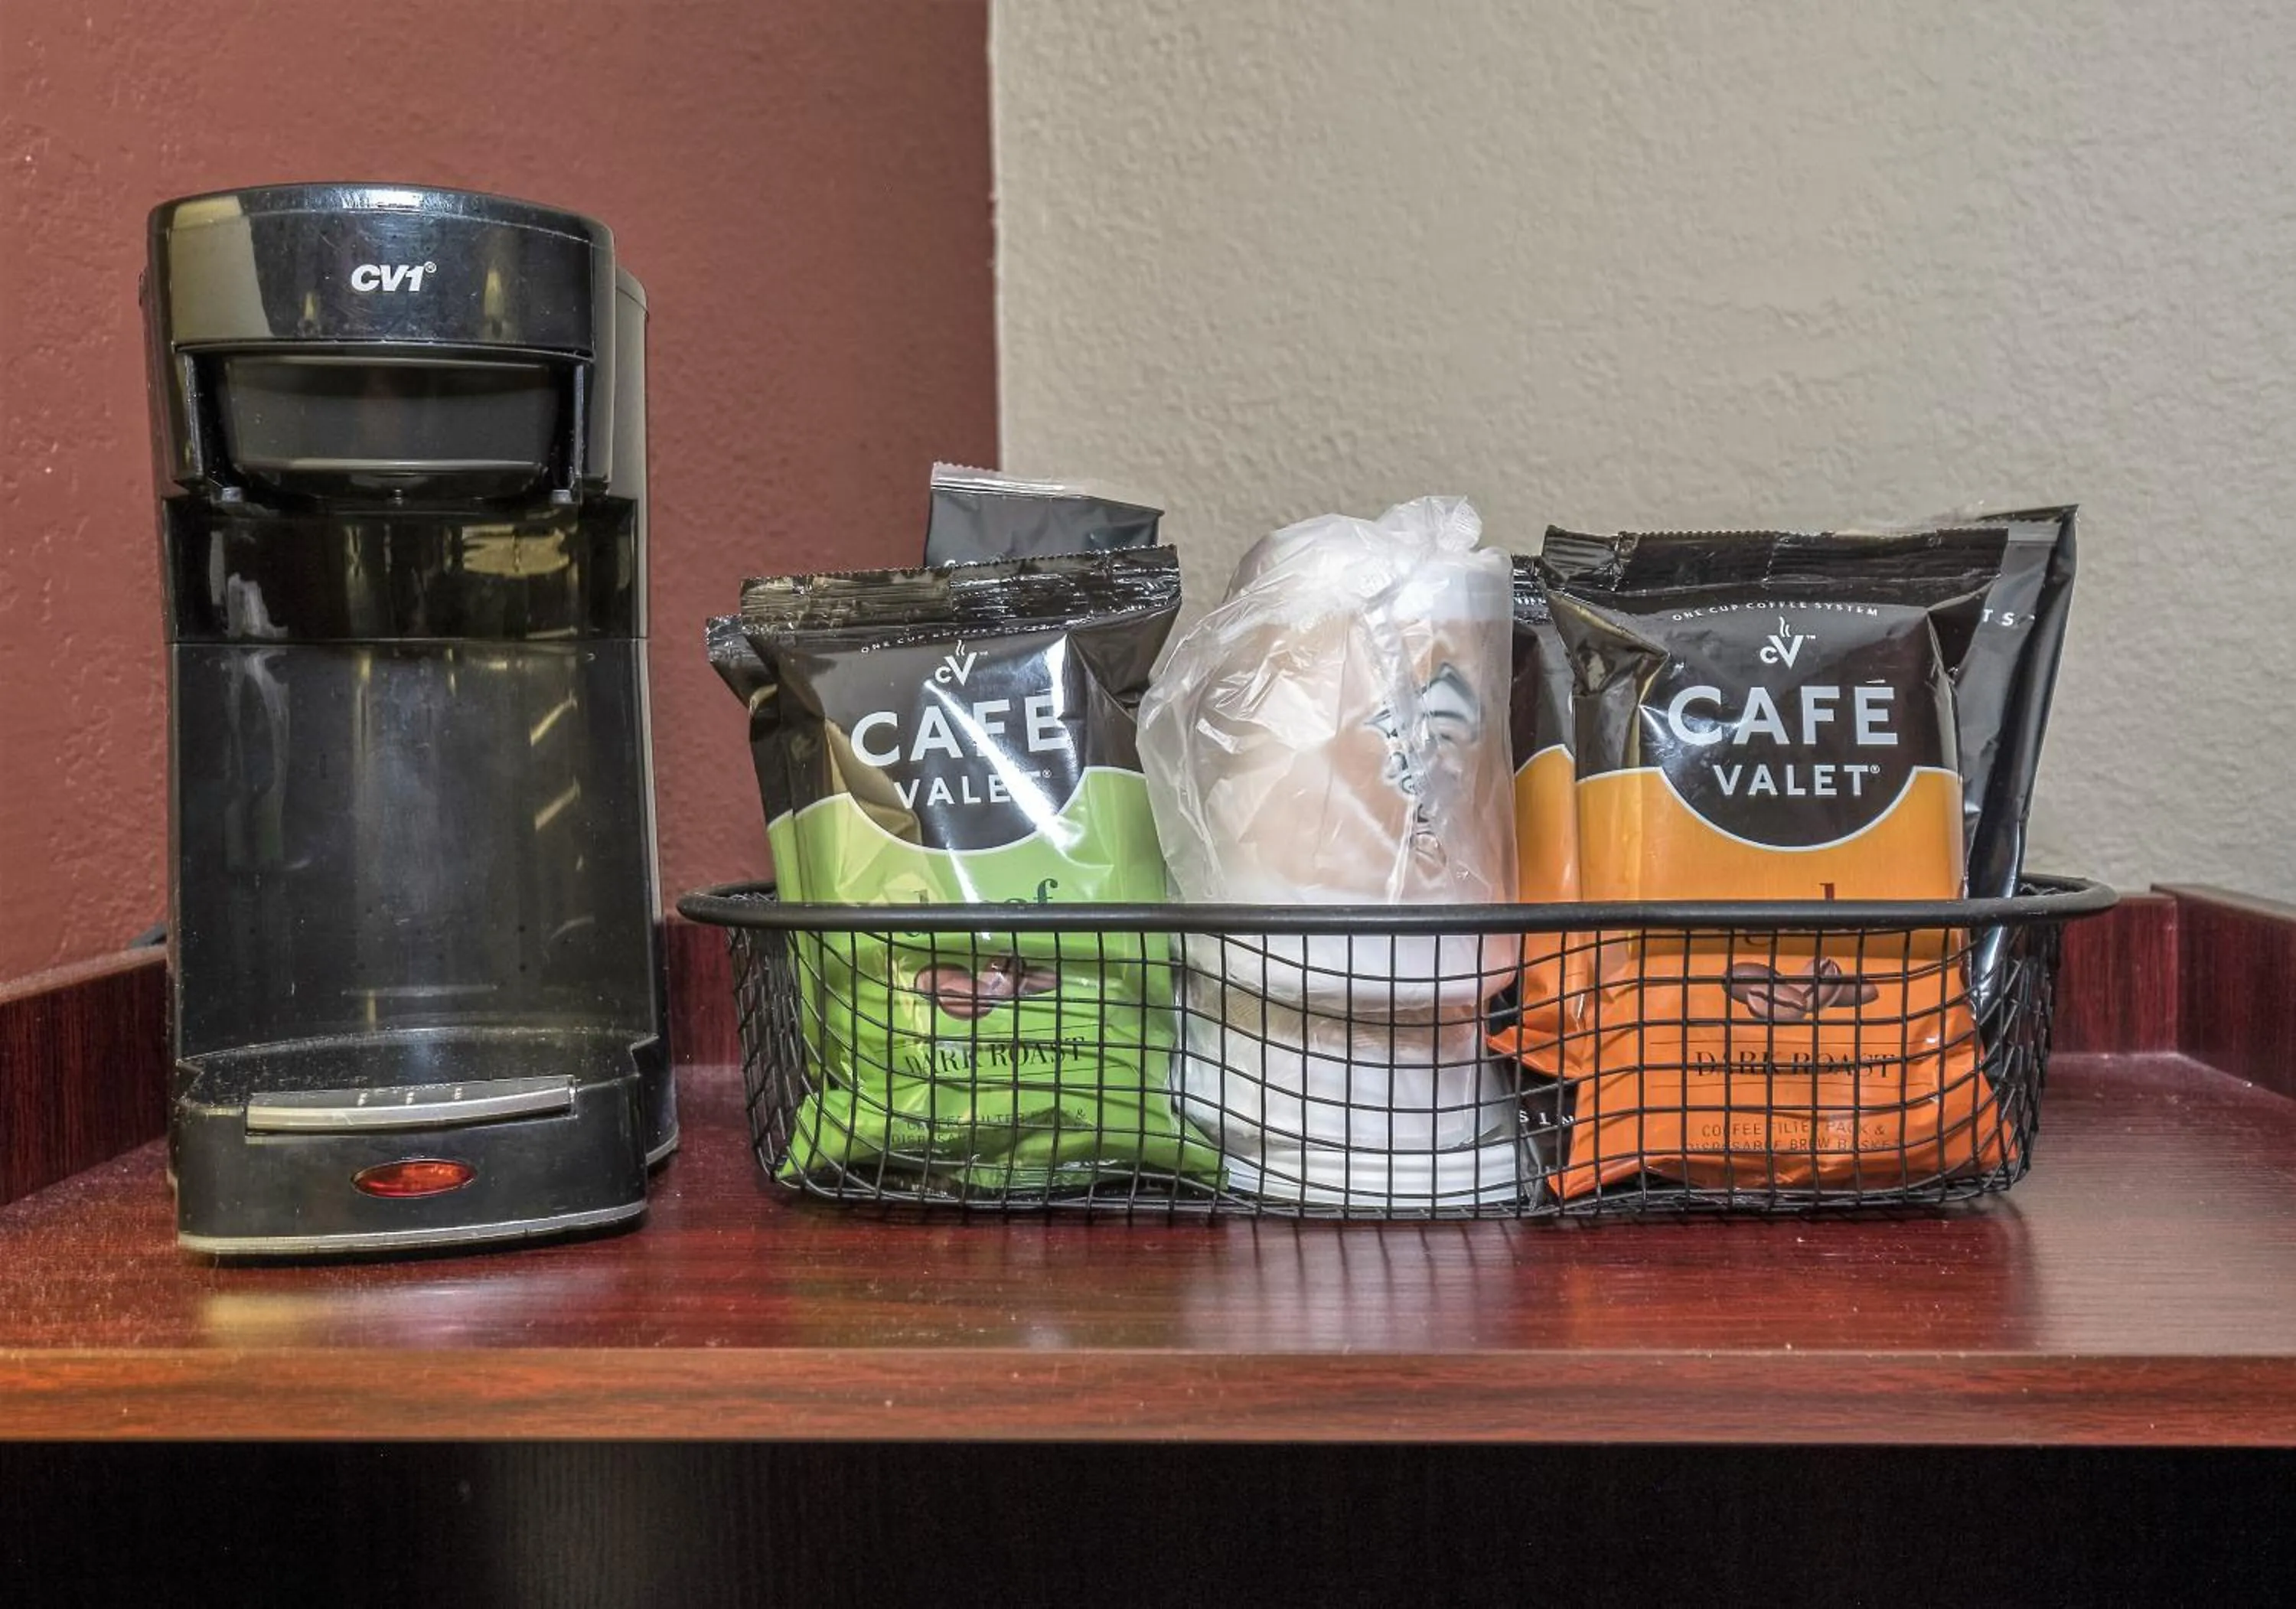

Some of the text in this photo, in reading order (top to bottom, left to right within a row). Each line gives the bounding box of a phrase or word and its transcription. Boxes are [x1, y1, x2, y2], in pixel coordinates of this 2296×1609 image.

[1672, 609, 1703, 622] ONE
[1709, 603, 1738, 614] CUP
[1668, 679, 1898, 746] CAFÉ
[1701, 1122, 1763, 1137] COFEE
[1789, 1137, 1830, 1152] BRW
